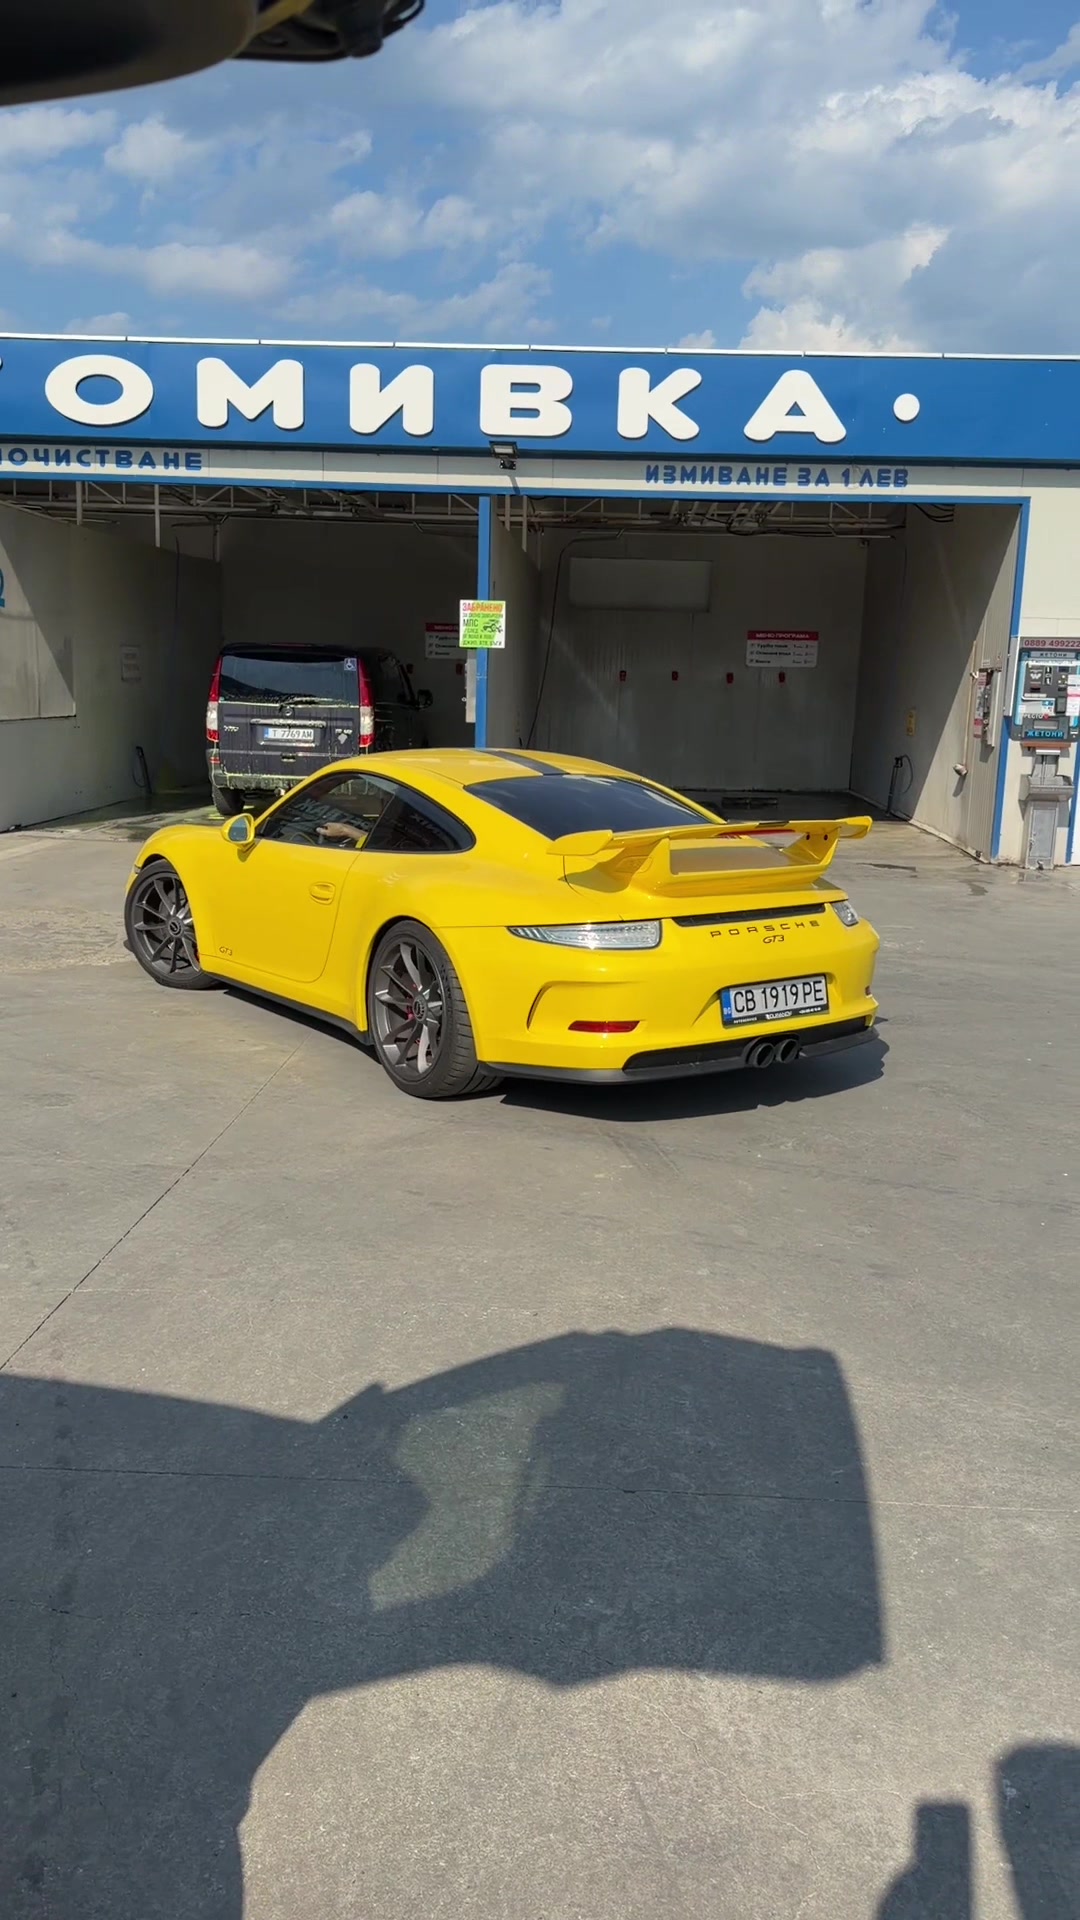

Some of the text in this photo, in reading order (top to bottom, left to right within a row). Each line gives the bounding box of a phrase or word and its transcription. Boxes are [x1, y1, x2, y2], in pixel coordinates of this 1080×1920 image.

[0, 353, 847, 444] ОМИВКА
[0, 447, 203, 472] ОЧИСТВАНЕ
[645, 464, 909, 489] ИЗМИВАНЕ ЗА 1 ЛЕВ
[463, 618, 479, 628] МПС
[1024, 639, 1047, 647] 0889
[1027, 730, 1063, 738] ЖЕТОНИ
[710, 919, 820, 938] PORSCHE
[762, 934, 785, 944] GT3
[733, 979, 825, 1013] CB 1919 PE
